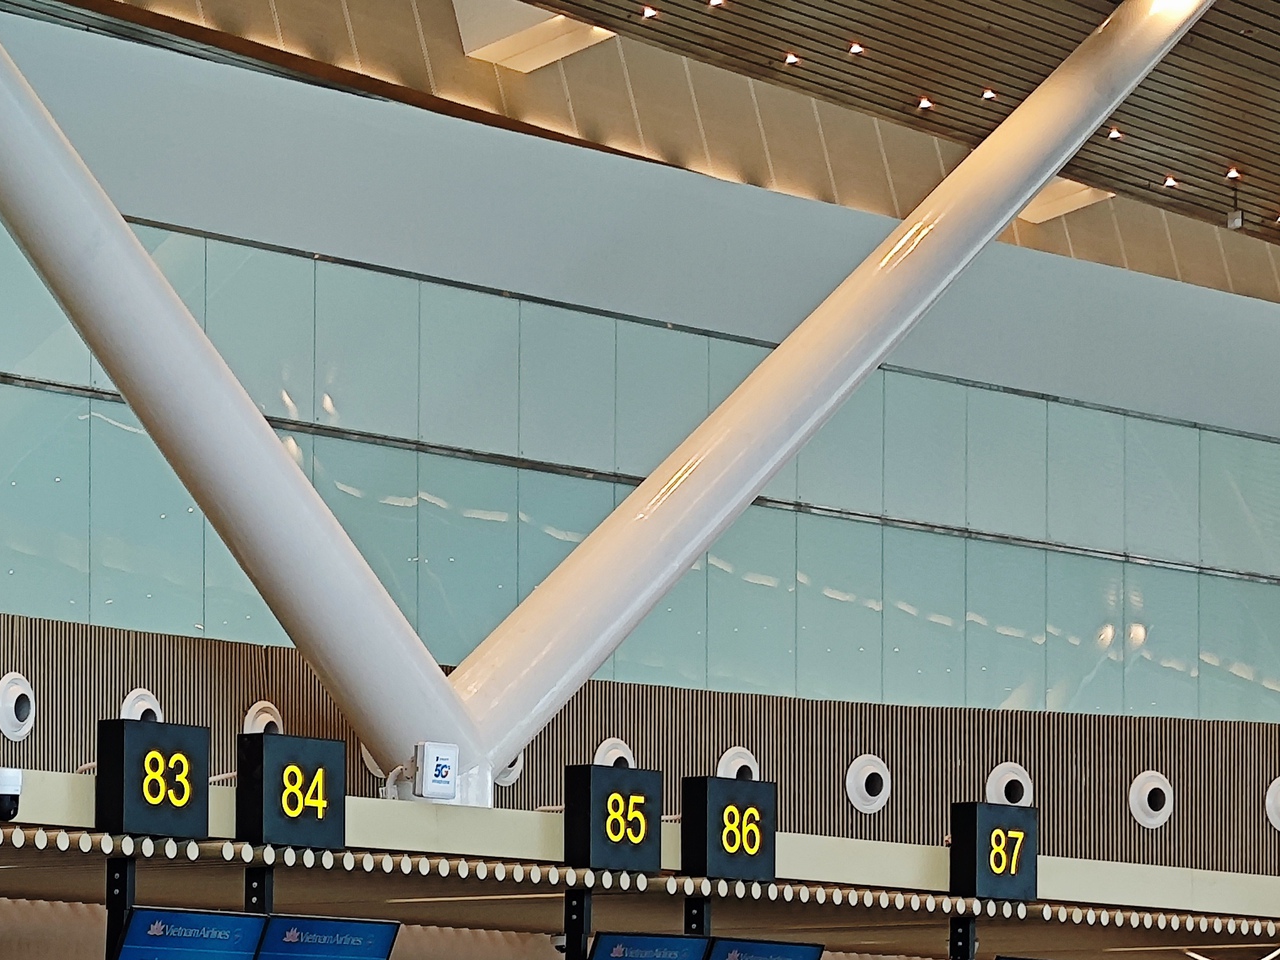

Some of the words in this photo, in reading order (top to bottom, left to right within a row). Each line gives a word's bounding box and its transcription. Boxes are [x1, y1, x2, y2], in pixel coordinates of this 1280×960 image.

[143, 750, 190, 807] 83
[282, 765, 327, 818] 84
[434, 763, 449, 778] 5G
[606, 792, 646, 844] 85
[722, 804, 760, 855] 86
[990, 828, 1025, 874] 87
